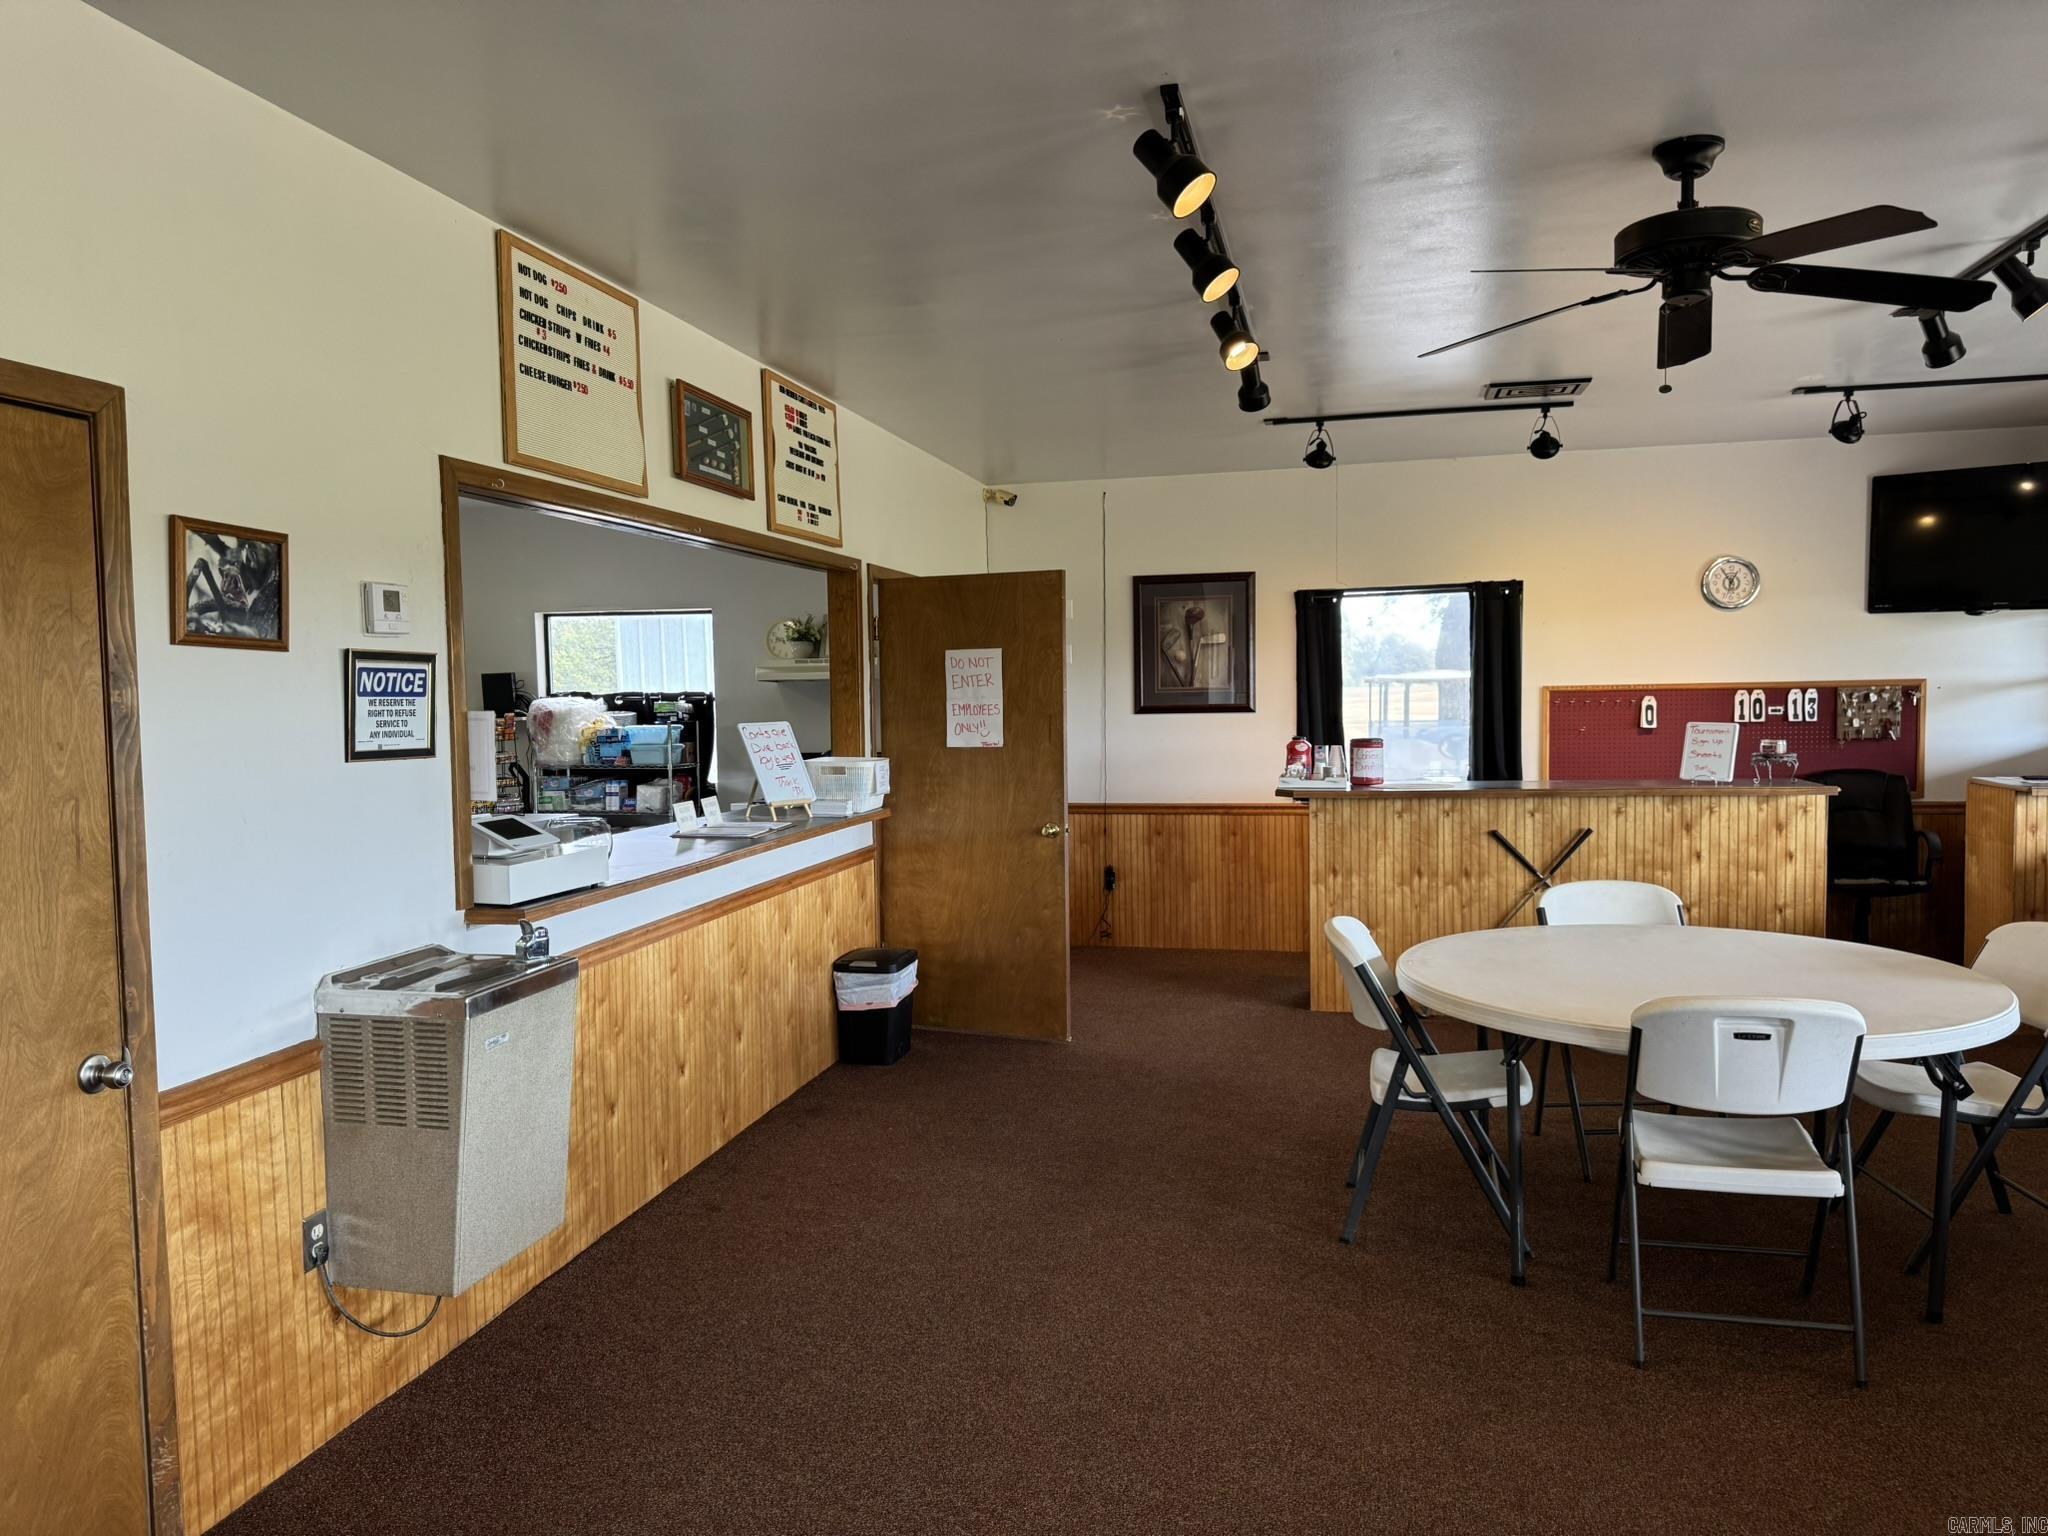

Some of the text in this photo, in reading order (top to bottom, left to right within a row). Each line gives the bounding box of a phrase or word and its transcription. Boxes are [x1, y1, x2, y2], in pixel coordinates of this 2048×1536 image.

[518, 262, 531, 278] HOT
[532, 269, 547, 285] DOG
[519, 286, 532, 302] HOT
[534, 293, 548, 309] DOG
[556, 304, 576, 321] CHIPS
[582, 316, 604, 334] DRINK
[584, 336, 601, 352] FRIES
[573, 356, 590, 372] FRIES
[599, 366, 616, 382] DRINK
[950, 656, 994, 669] DO NOT
[359, 671, 426, 693] NOTICE
[952, 672, 994, 690] ENTER
[368, 698, 416, 707] WE RESERVE THE
[952, 703, 1000, 717] EMPLOYEES
[368, 708, 416, 717] RIGHT TO REFUSE
[375, 720, 408, 728] SERVICE TO
[370, 729, 414, 739] ANY INDIVIDUAL
